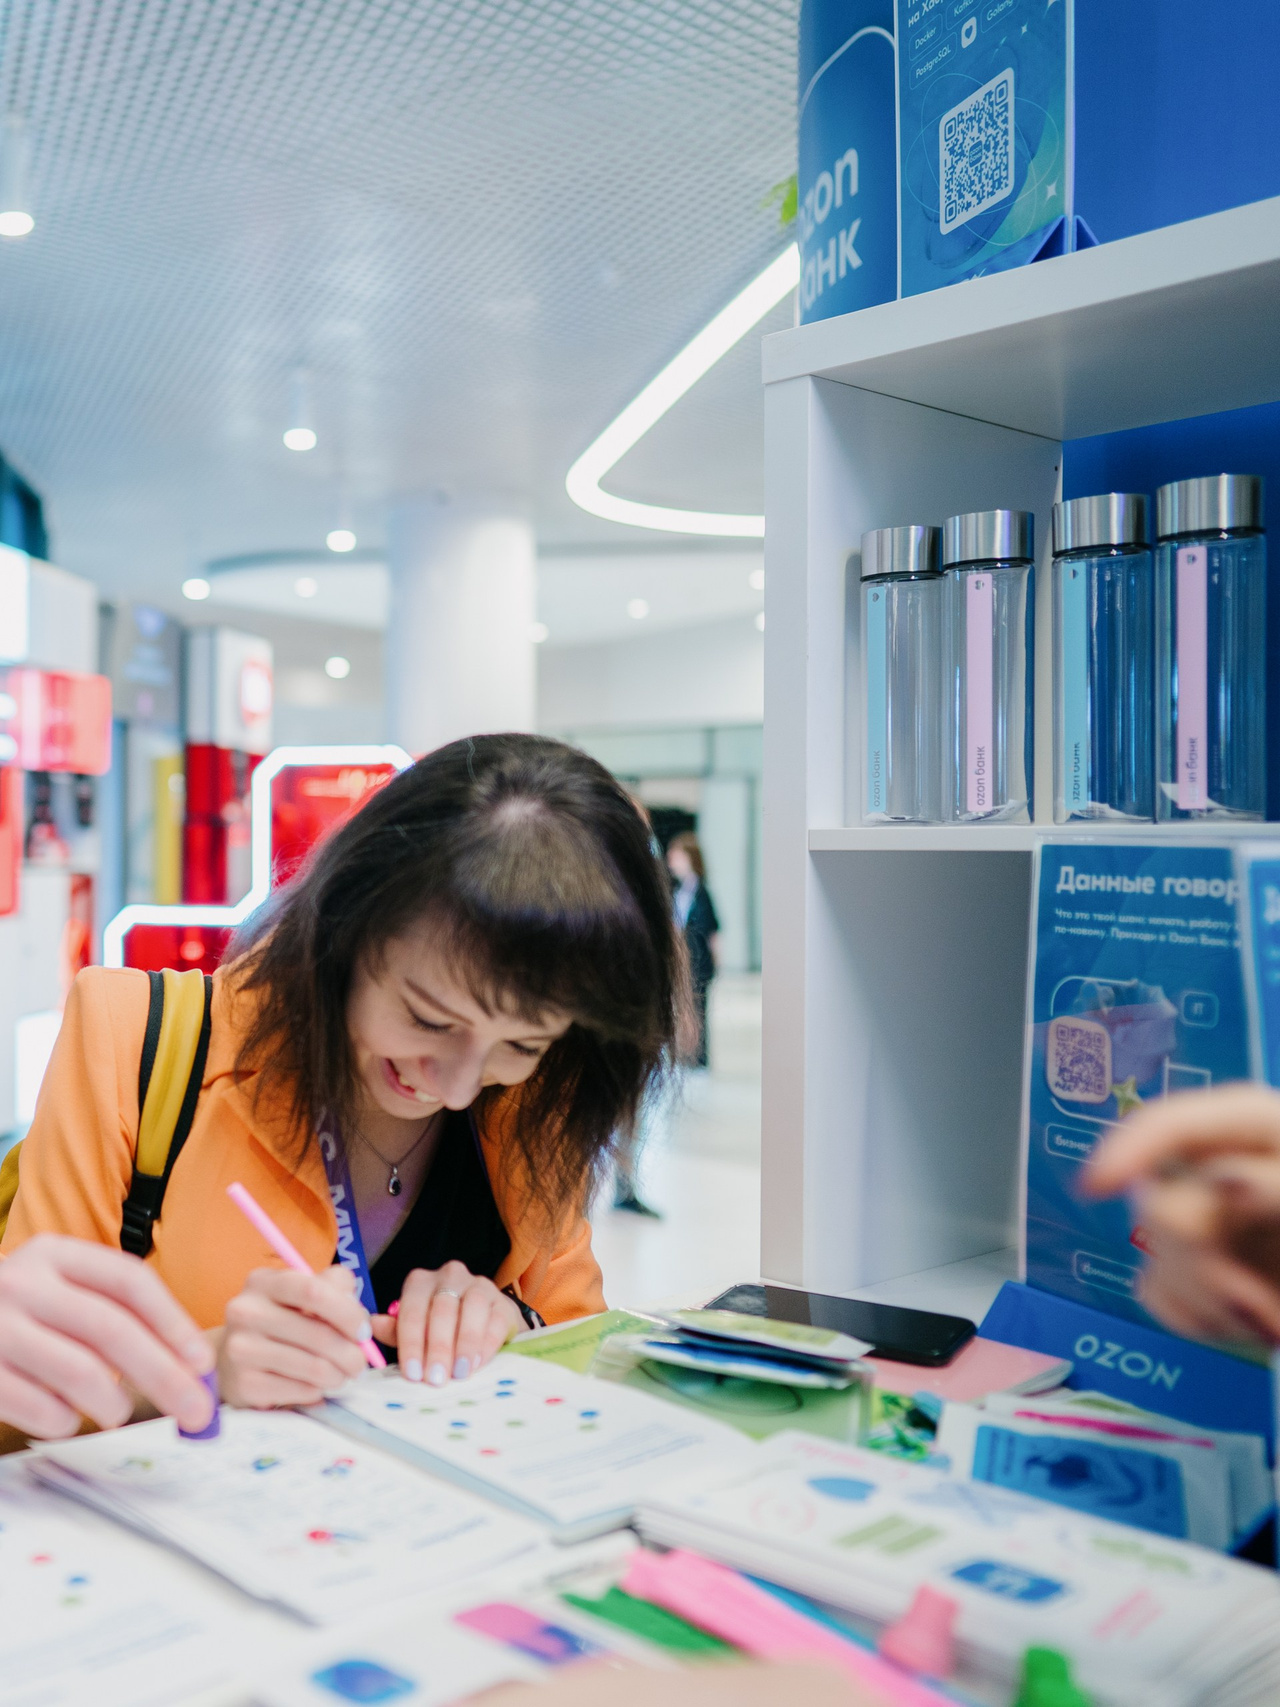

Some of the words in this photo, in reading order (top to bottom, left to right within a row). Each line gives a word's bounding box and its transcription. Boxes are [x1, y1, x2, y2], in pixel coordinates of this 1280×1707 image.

[987, 0, 1014, 21] Golang
[915, 27, 937, 50] Docker
[916, 44, 952, 79] PostgreSQL
[974, 746, 985, 776] банк
[976, 778, 985, 806] ozon
[1056, 865, 1156, 895] Данные
[1074, 1334, 1184, 1391] OZON
